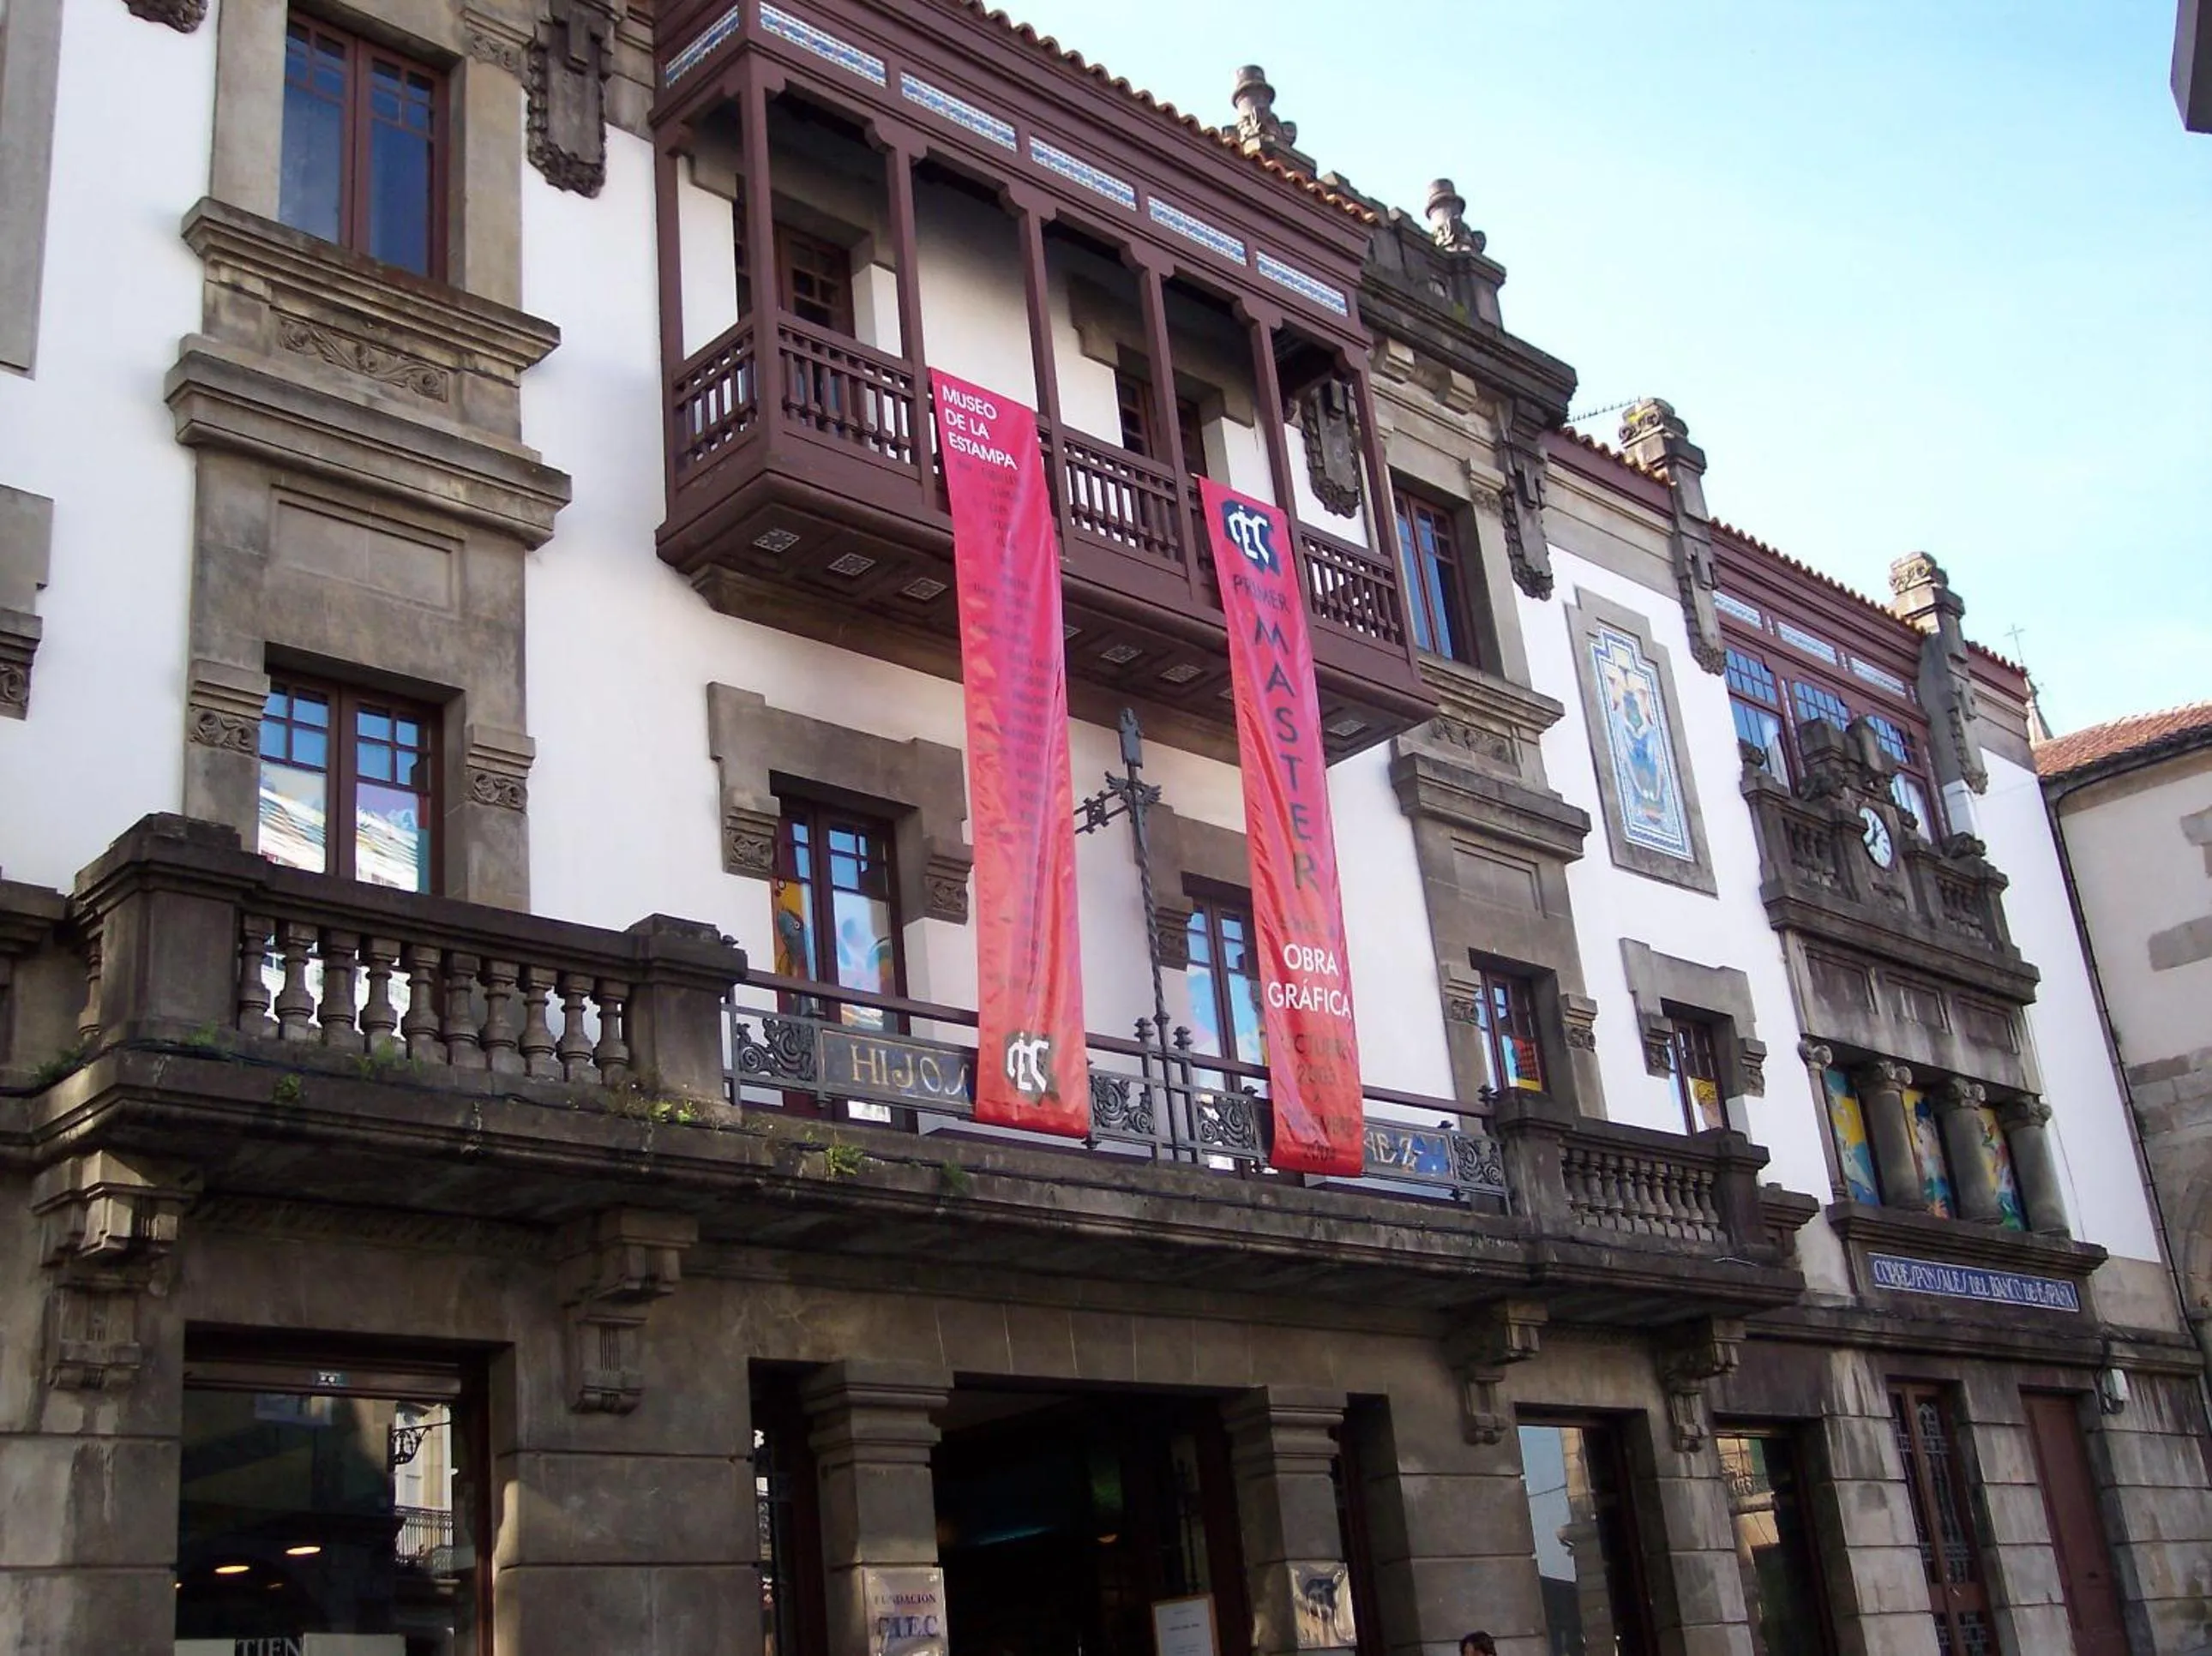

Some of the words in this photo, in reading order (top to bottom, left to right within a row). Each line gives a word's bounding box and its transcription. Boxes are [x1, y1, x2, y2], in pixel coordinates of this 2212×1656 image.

[942, 385, 997, 420] MUSEO
[945, 409, 966, 431] DE
[970, 418, 990, 440] LA
[948, 432, 1019, 471] ESTAMPA
[1254, 615, 1320, 893] MASTER
[1283, 943, 1338, 976] OBRA
[1267, 978, 1352, 1020] GRÁFICA
